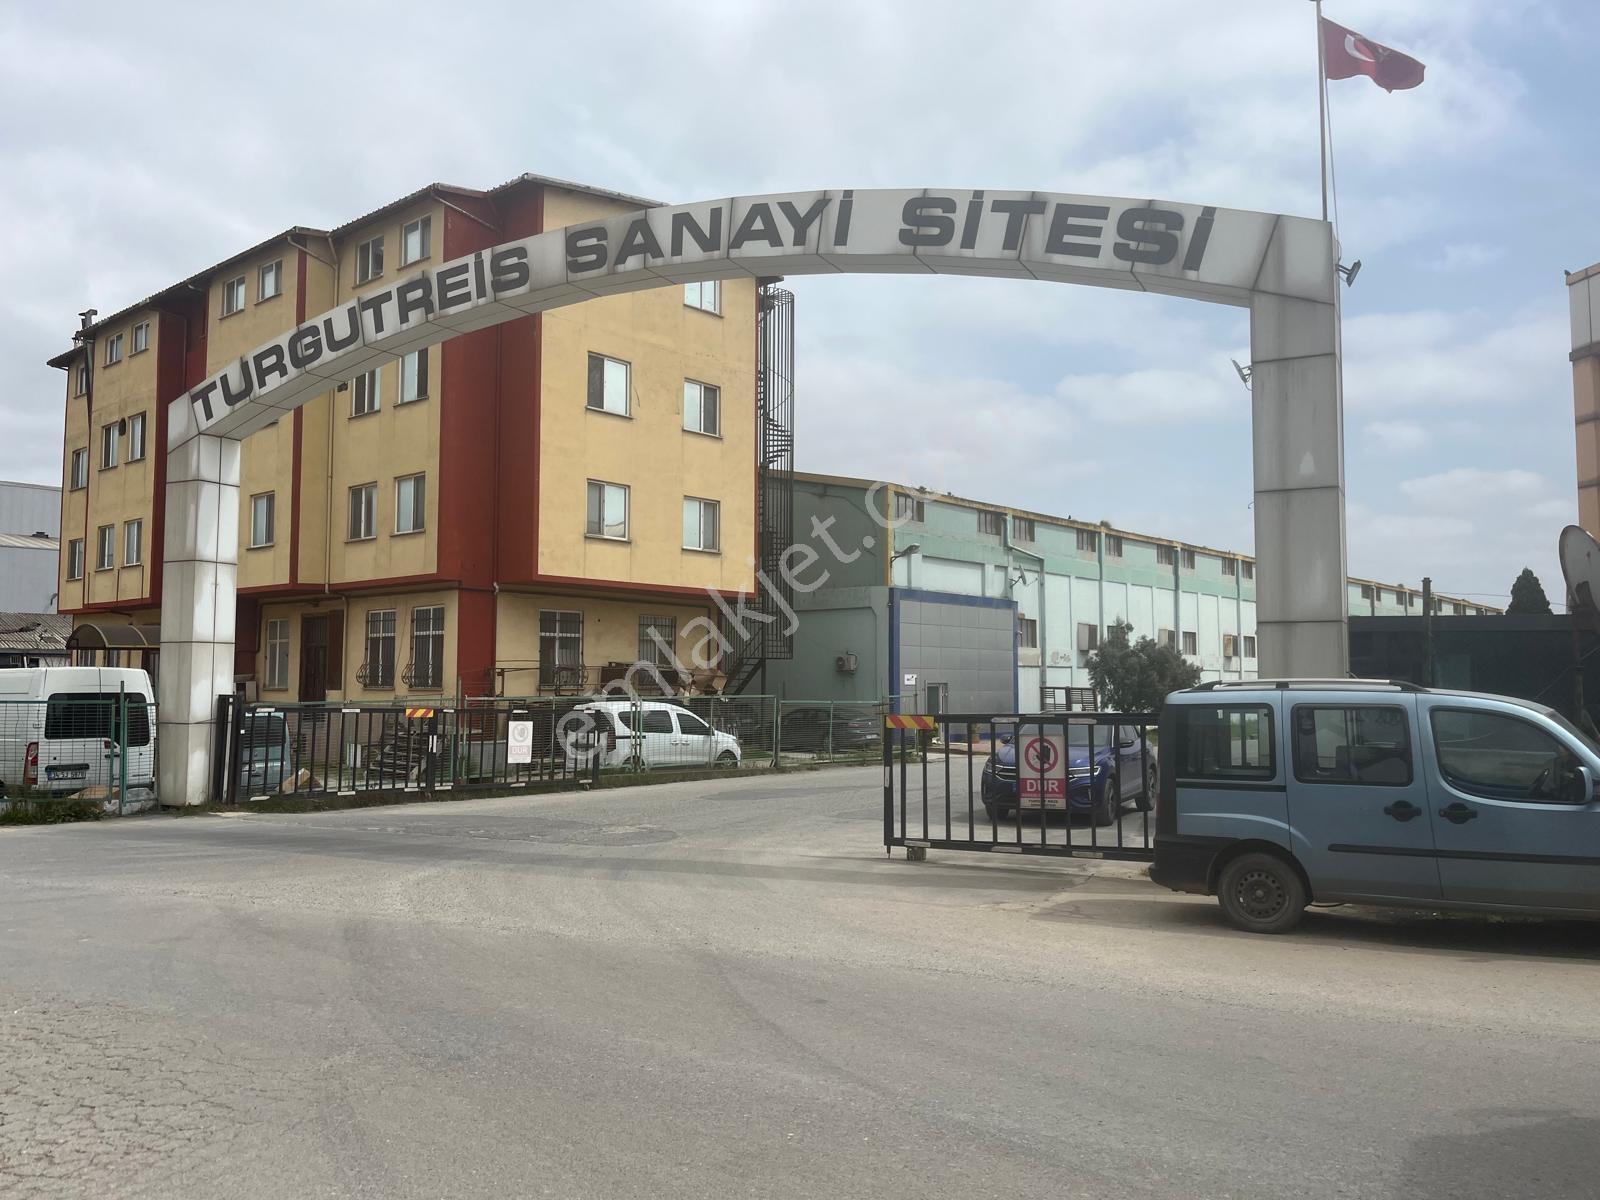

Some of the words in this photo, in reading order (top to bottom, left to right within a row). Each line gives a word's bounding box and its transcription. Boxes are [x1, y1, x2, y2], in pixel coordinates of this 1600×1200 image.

[190, 246, 530, 422] TURGUTREİS
[566, 189, 854, 274] SANAYİ
[898, 189, 1218, 272] SİTESİ
[1026, 779, 1059, 792] DUR
